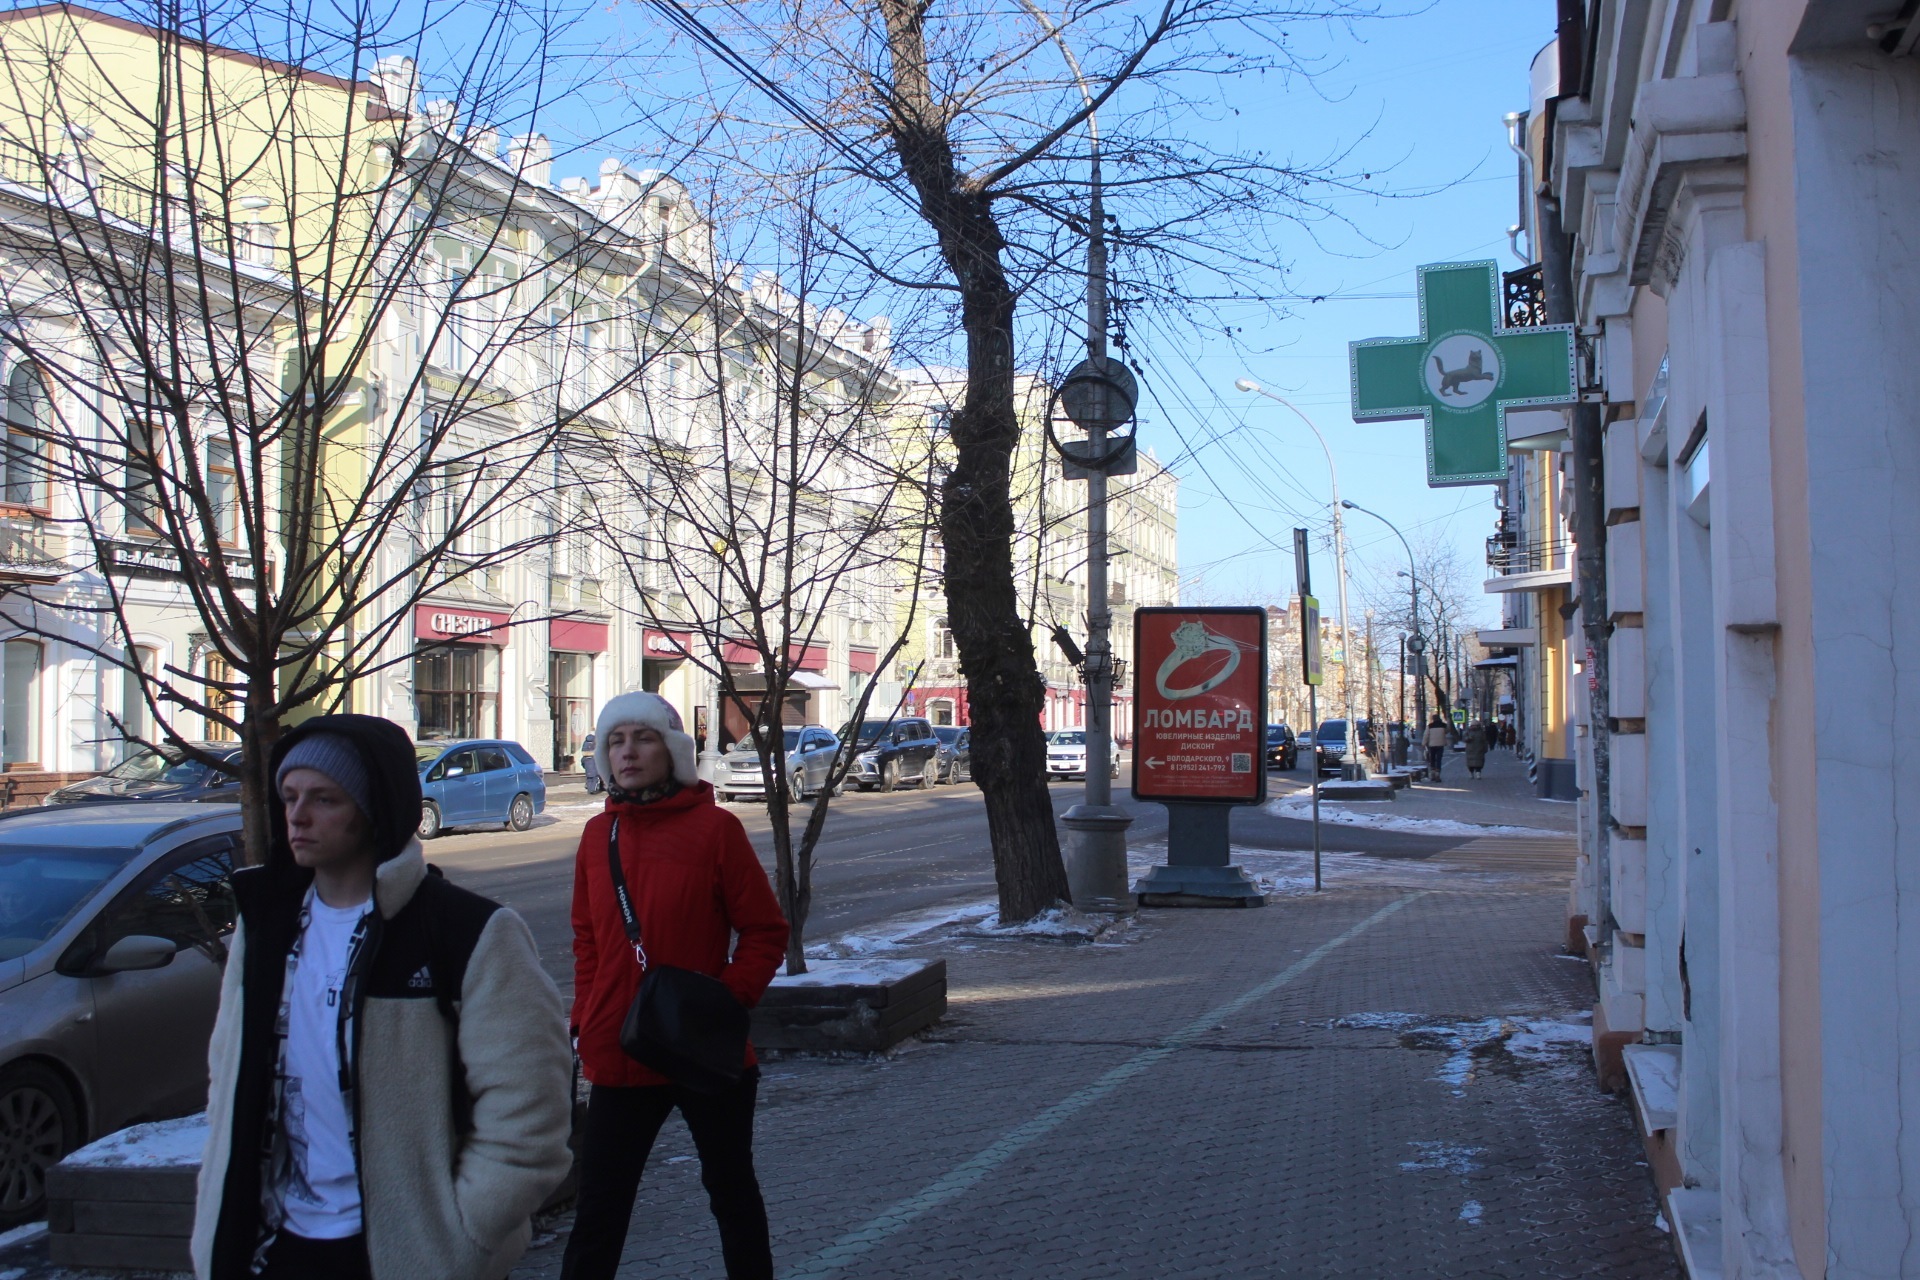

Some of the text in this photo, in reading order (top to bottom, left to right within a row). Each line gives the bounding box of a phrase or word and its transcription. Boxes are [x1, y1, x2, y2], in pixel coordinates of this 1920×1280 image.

[431, 613, 492, 636] CHESTER
[1144, 709, 1253, 732] ЛОМБАРД
[1205, 733, 1241, 741] ИЗДЕЛИЯ
[1166, 755, 1224, 763] ВОЛОДАРСКОГО,
[408, 978, 432, 988] adid
